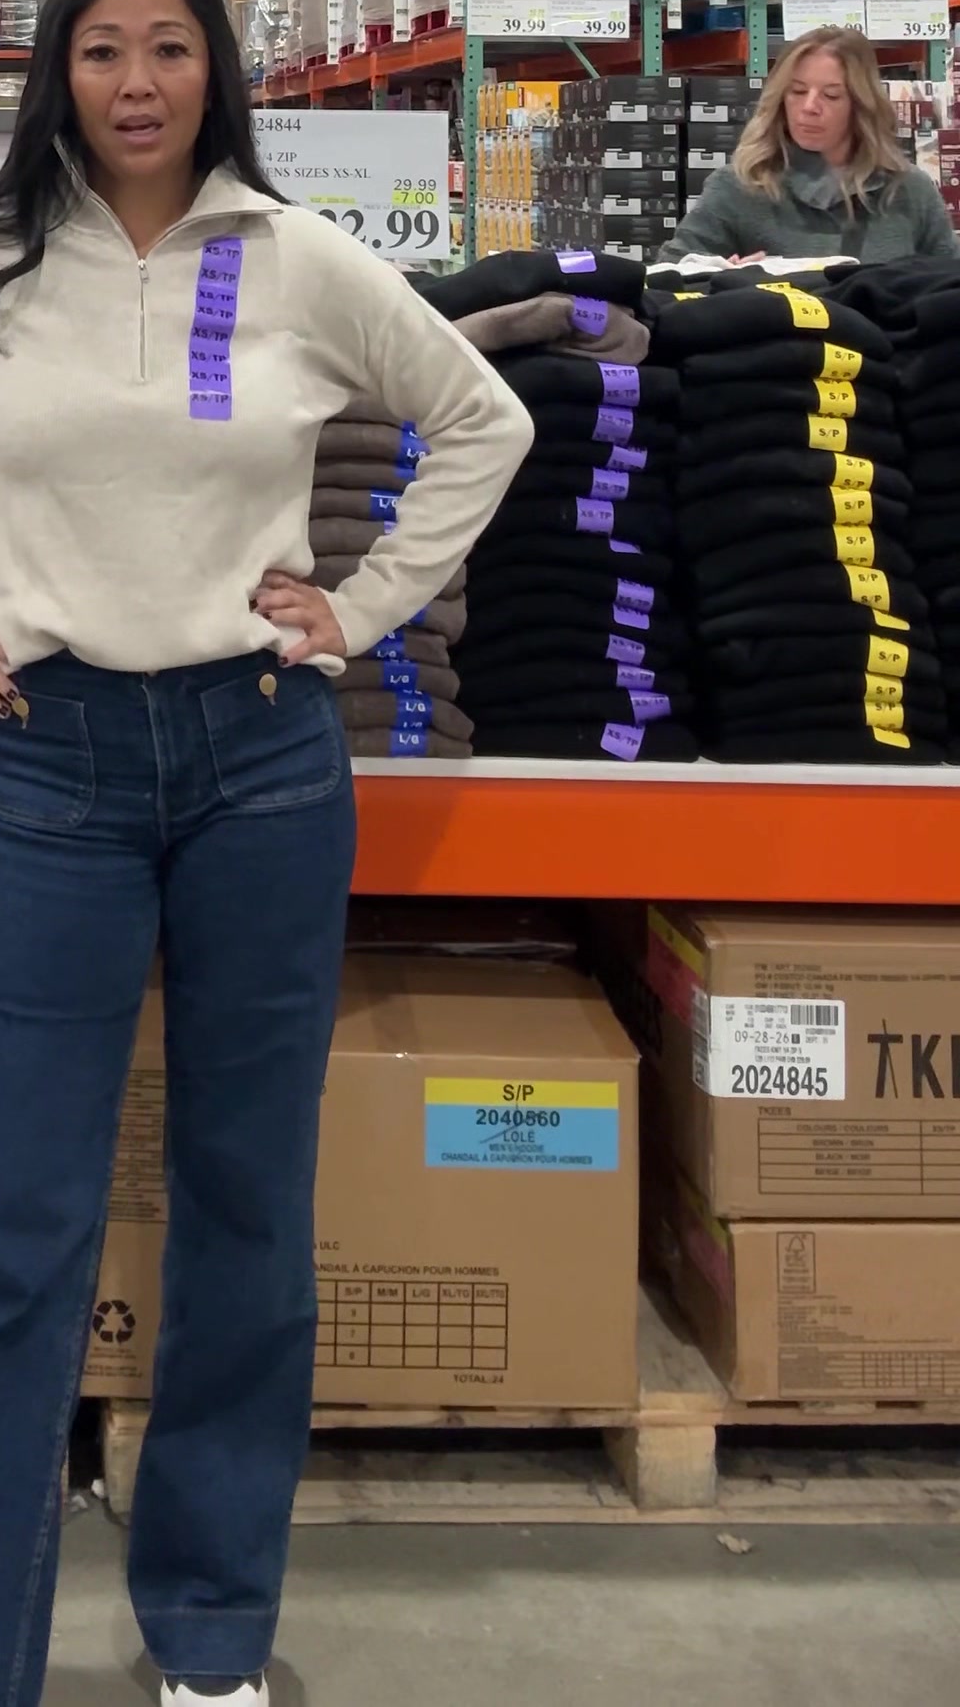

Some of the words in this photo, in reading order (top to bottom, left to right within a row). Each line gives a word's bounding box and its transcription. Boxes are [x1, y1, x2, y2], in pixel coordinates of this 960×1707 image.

[503, 19, 545, 33] 39.99
[583, 21, 626, 35] 39.99
[903, 22, 947, 36] 39.99
[253, 118, 302, 132] 24844
[277, 152, 297, 162] ZIP
[294, 168, 329, 179] SIZES
[333, 168, 371, 179] XS-XL
[394, 179, 437, 191] 29.99
[394, 192, 435, 204] -7.00
[205, 246, 240, 259] XS/TP
[200, 268, 237, 283] XS/TP
[197, 306, 234, 319] XS/TP
[575, 308, 605, 322] XS/TP
[802, 307, 821, 316] S/P
[192, 327, 229, 342] XS/TP
[191, 351, 227, 362] XS/TP
[835, 351, 856, 360] S/P
[192, 372, 228, 382] XS/TP
[604, 369, 635, 377] XS/TP
[192, 394, 229, 403] XS/TP
[605, 389, 637, 398] XS/TP
[829, 392, 849, 400] S/P
[819, 428, 840, 437] S/P
[846, 458, 865, 467] S/P
[595, 480, 626, 493] XS/TP
[844, 478, 864, 488] S/P
[844, 501, 865, 510] S/P
[580, 509, 612, 519] XS/TP
[846, 536, 867, 545] S/P
[858, 573, 878, 582] S/P
[861, 594, 882, 604] S/P
[878, 651, 900, 662] S/P
[390, 675, 409, 684] L/G
[876, 685, 896, 695] S/P
[405, 702, 426, 712] L/G
[875, 701, 896, 711] S/P
[399, 733, 420, 744] L/G
[607, 729, 639, 747] XS/TP
[735, 1030, 790, 1044] 09-28-26
[731, 1064, 828, 1097] 2024845
[502, 1084, 534, 1101] S/P
[441, 1152, 480, 1162] CHANDAIL
[319, 1241, 340, 1250] ULC
[362, 1264, 420, 1275] CAPUCHON
[423, 1265, 451, 1275] POUR
[454, 1266, 500, 1277] HOMMES
